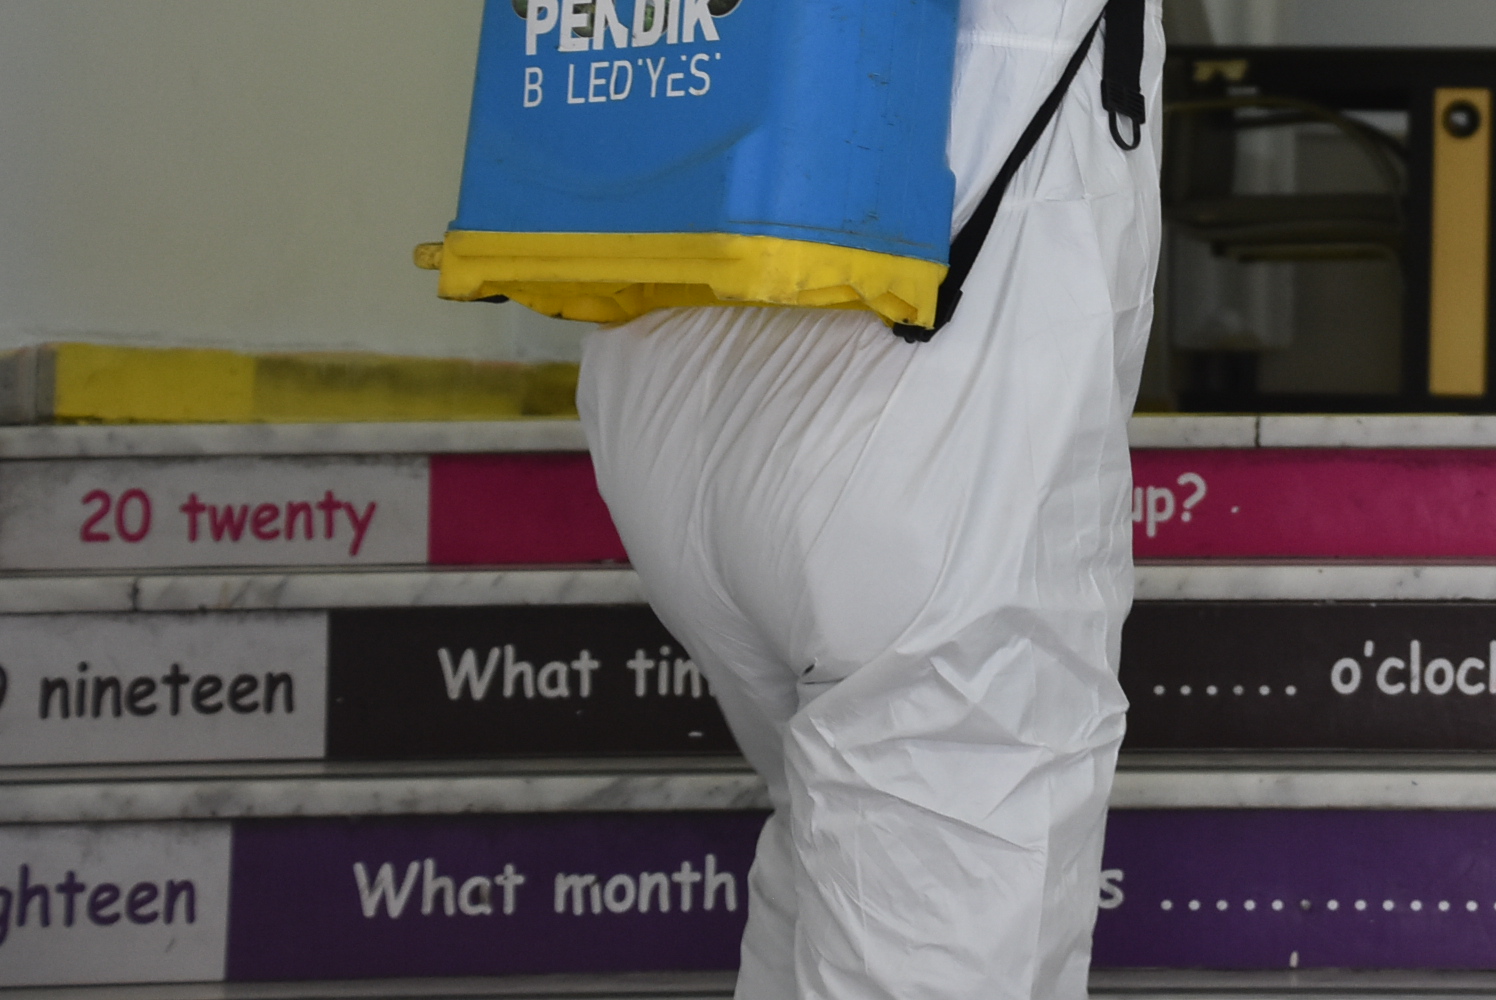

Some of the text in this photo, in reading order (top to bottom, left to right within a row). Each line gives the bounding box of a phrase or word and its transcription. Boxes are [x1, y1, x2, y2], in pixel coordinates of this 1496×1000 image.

[79, 488, 377, 557] 20 twenty
[39, 661, 295, 720] nineteen
[437, 645, 600, 701] What
[353, 853, 738, 919] What month
